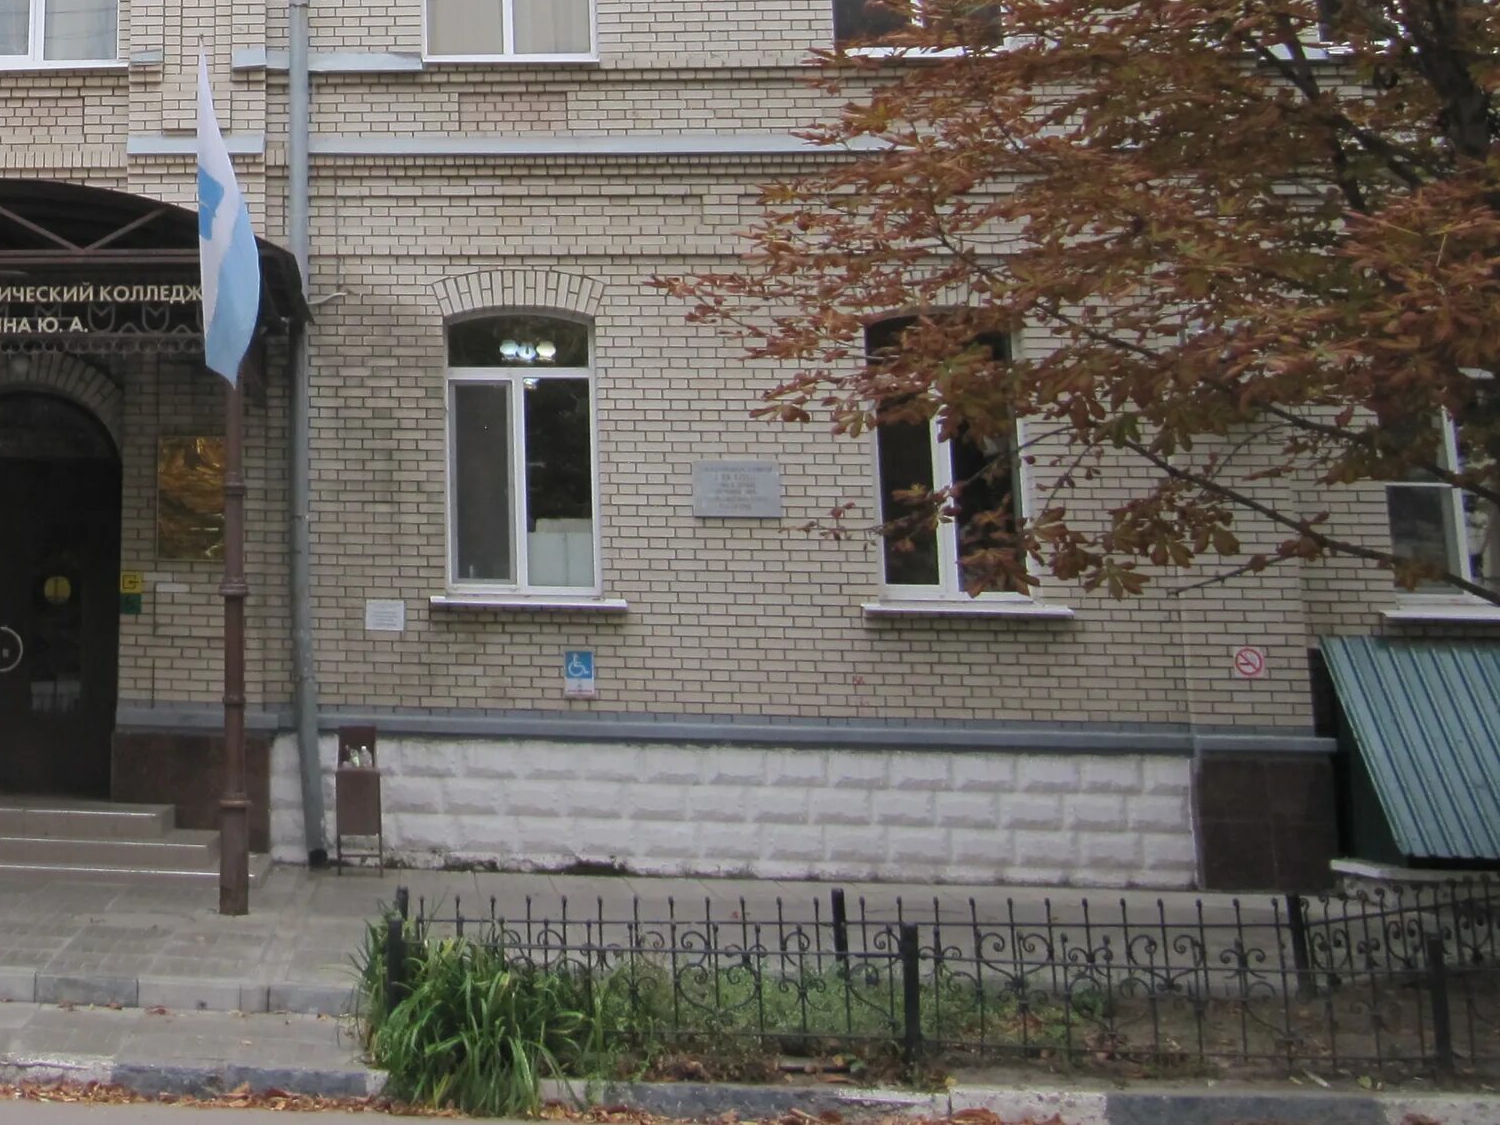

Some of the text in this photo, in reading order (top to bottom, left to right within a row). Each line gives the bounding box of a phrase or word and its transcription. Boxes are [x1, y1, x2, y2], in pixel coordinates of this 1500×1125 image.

[100, 285, 203, 304] КОЛЛЕДЖ
[38, 317, 63, 333] Ю.
[69, 316, 89, 333] А.
